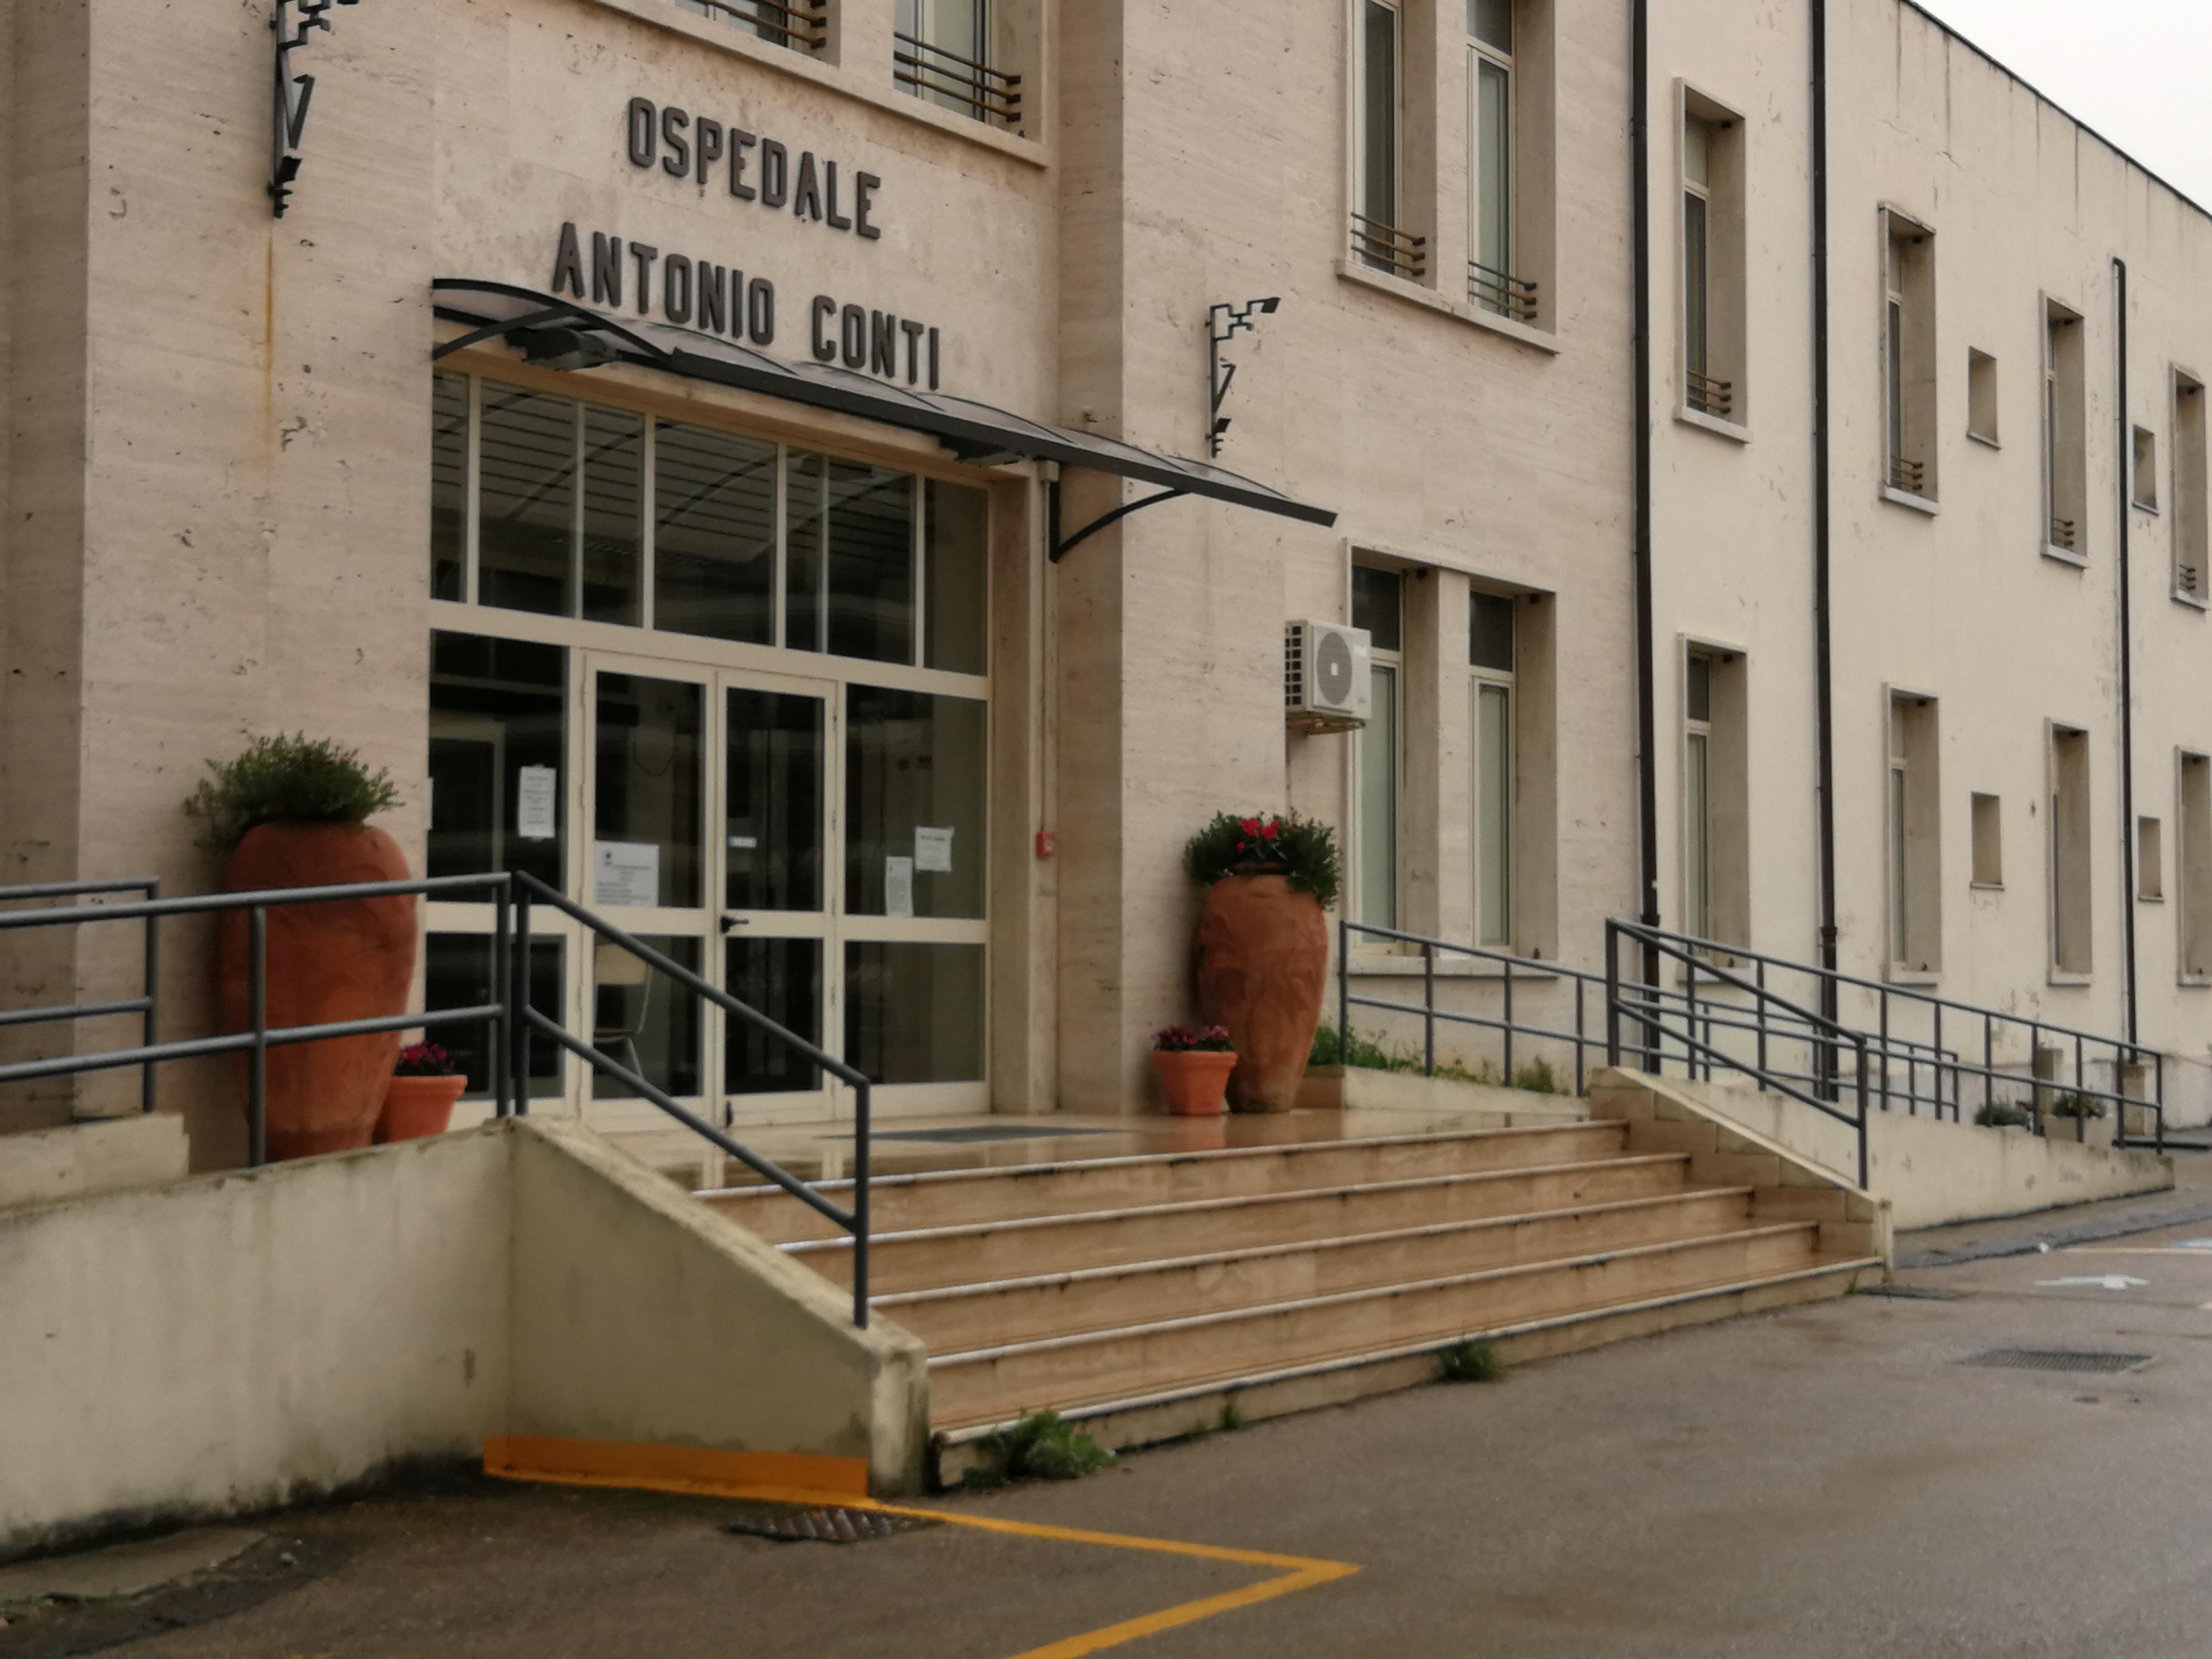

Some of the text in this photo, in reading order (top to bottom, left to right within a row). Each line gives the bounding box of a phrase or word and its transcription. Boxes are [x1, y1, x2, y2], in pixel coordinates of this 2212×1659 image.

[628, 97, 881, 238] OSPEDALE
[552, 221, 939, 390] ANTONIO CONTI
